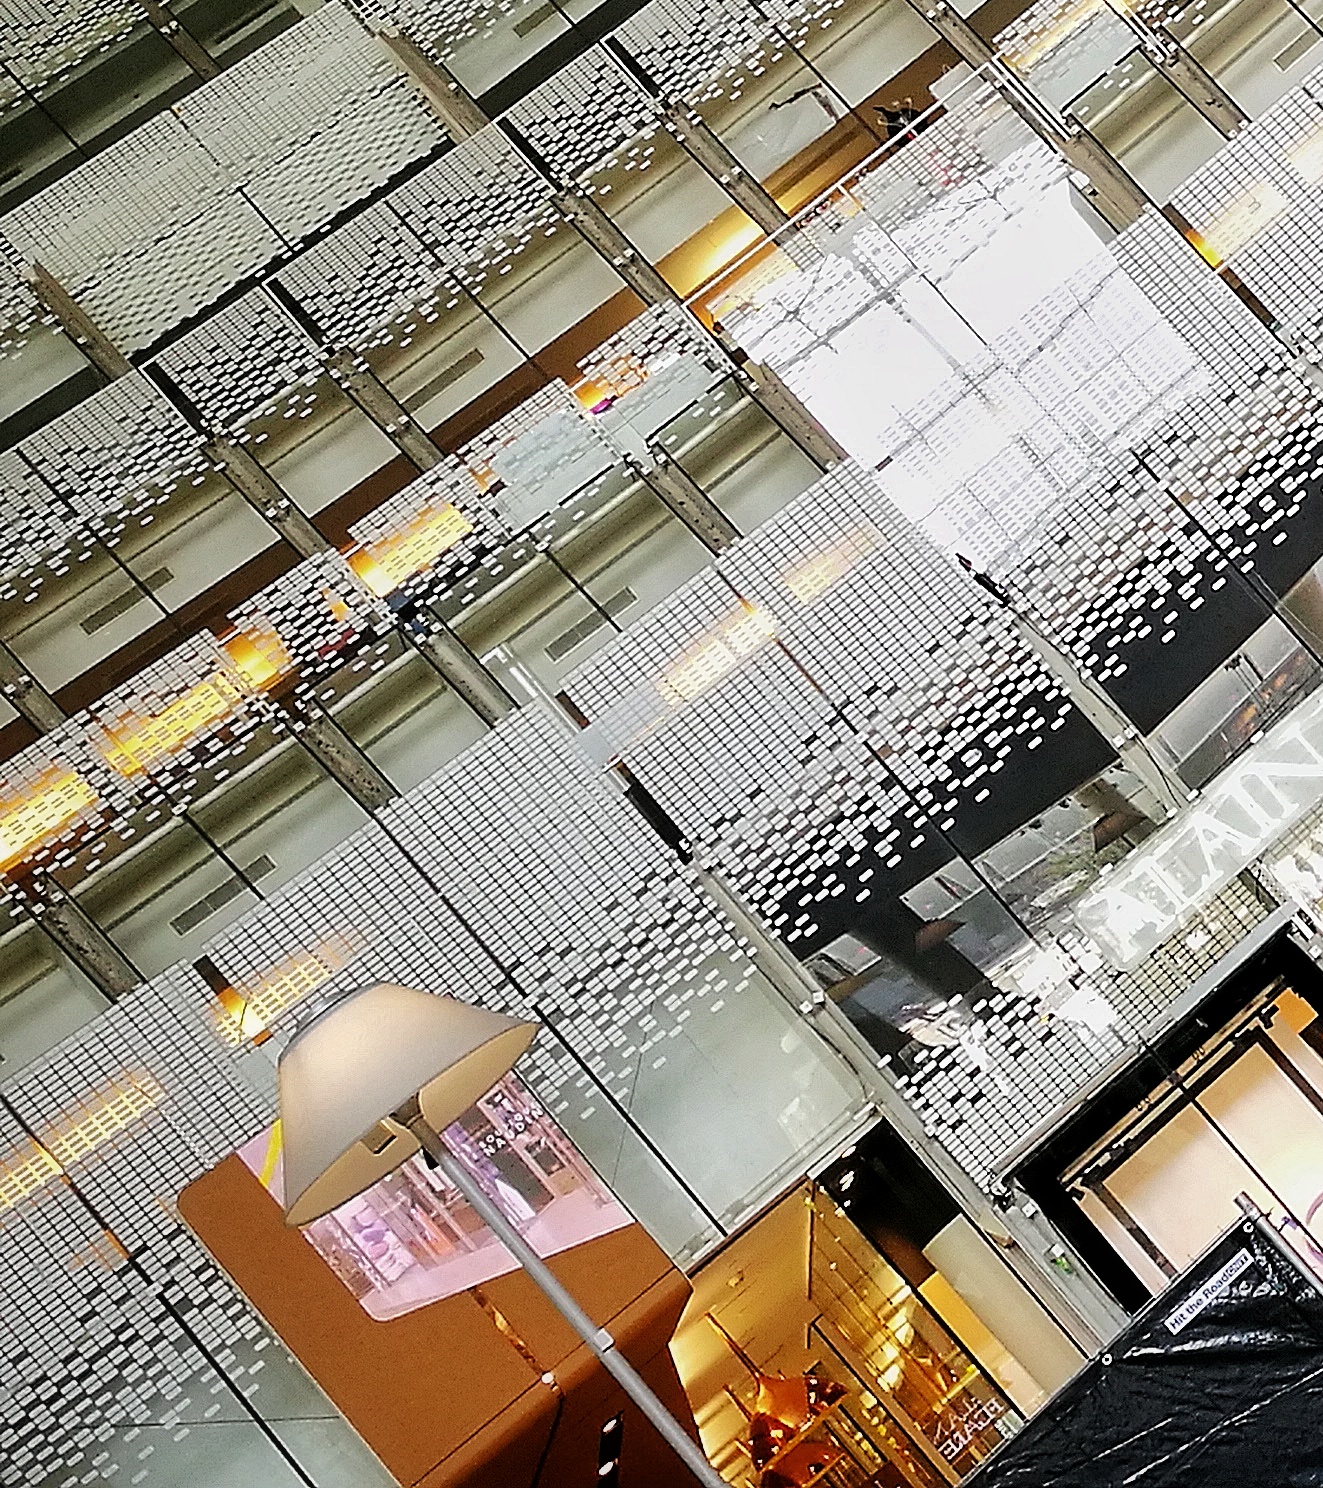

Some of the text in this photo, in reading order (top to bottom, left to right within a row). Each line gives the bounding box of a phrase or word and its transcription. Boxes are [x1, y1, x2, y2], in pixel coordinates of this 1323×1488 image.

[483, 1107, 545, 1157] NAUDIN
[1170, 1311, 1188, 1330] Hit
[1185, 1295, 1204, 1315] the
[1202, 1272, 1230, 1299] Road
